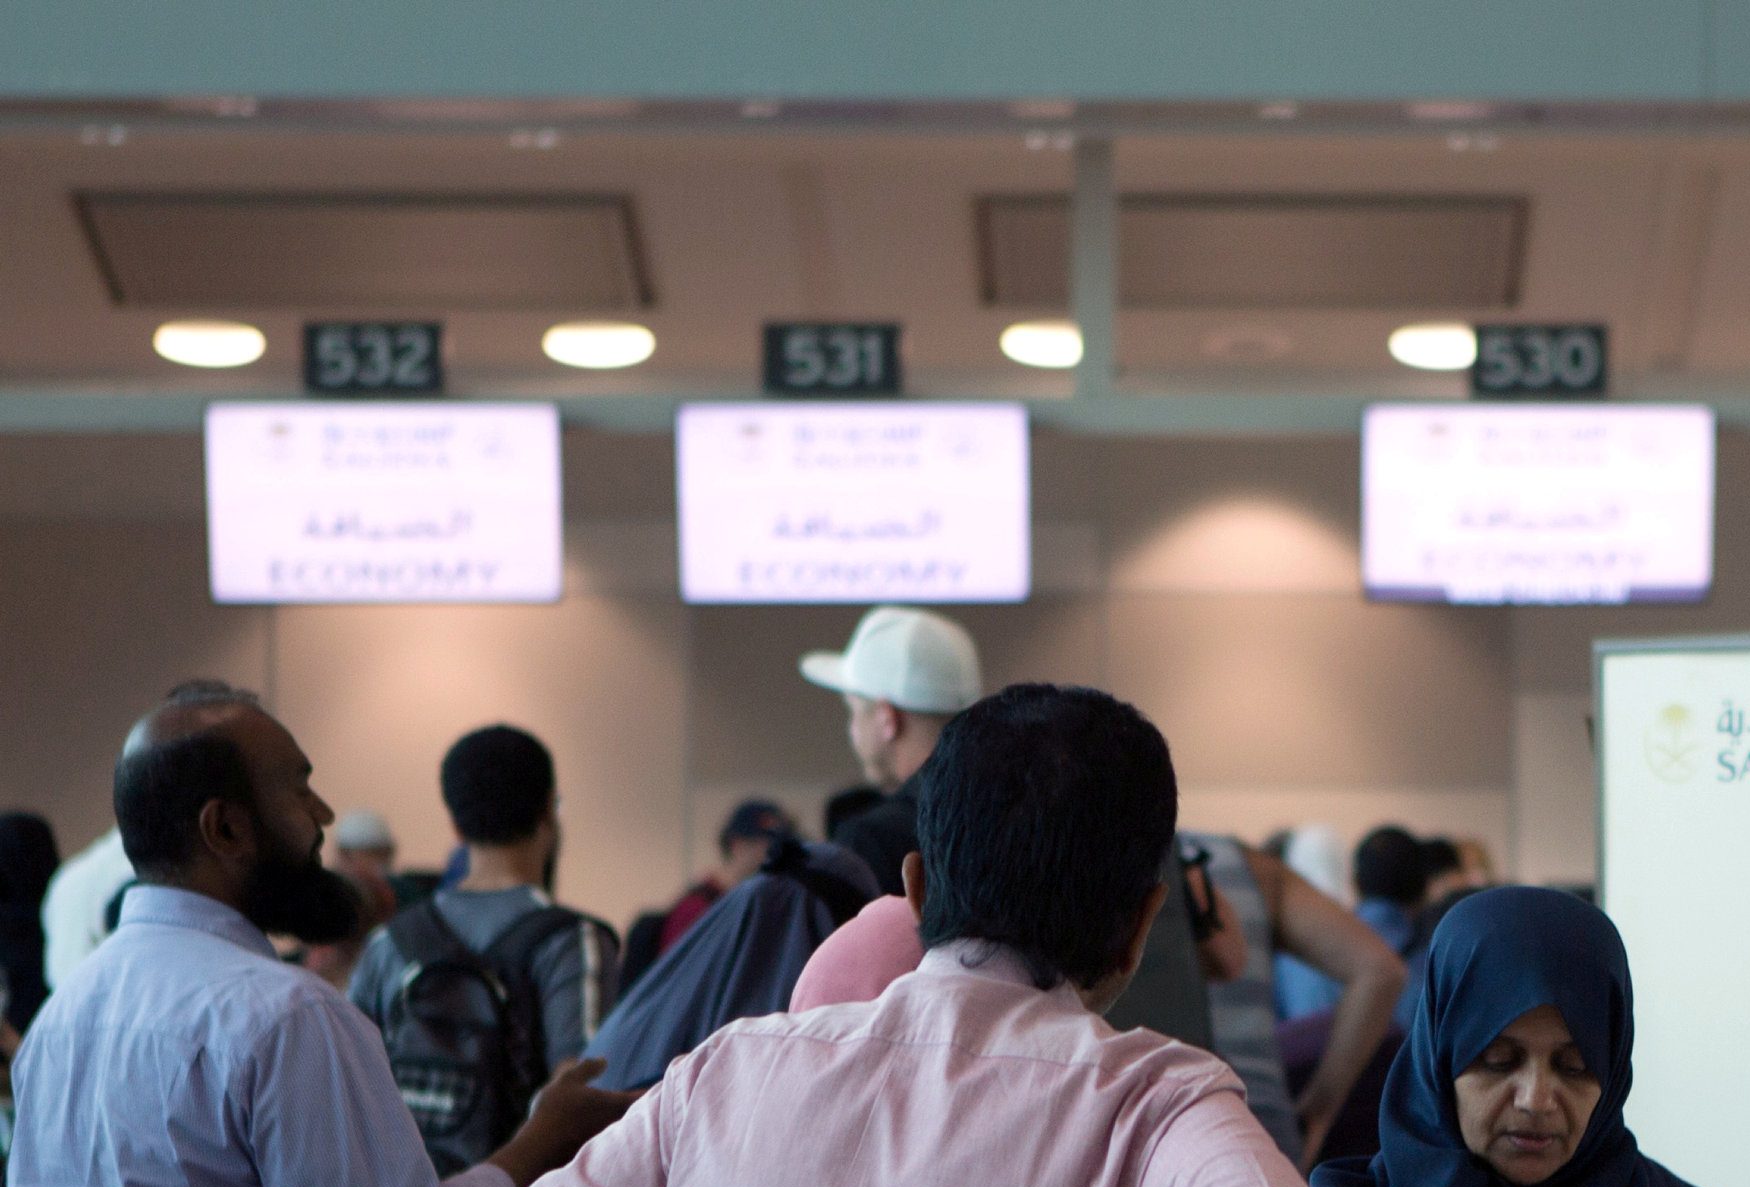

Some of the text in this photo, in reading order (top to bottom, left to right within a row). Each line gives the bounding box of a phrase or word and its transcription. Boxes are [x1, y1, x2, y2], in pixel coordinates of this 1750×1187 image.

[315, 334, 438, 390] 532
[779, 334, 886, 390] 531
[1478, 335, 1598, 391] 530
